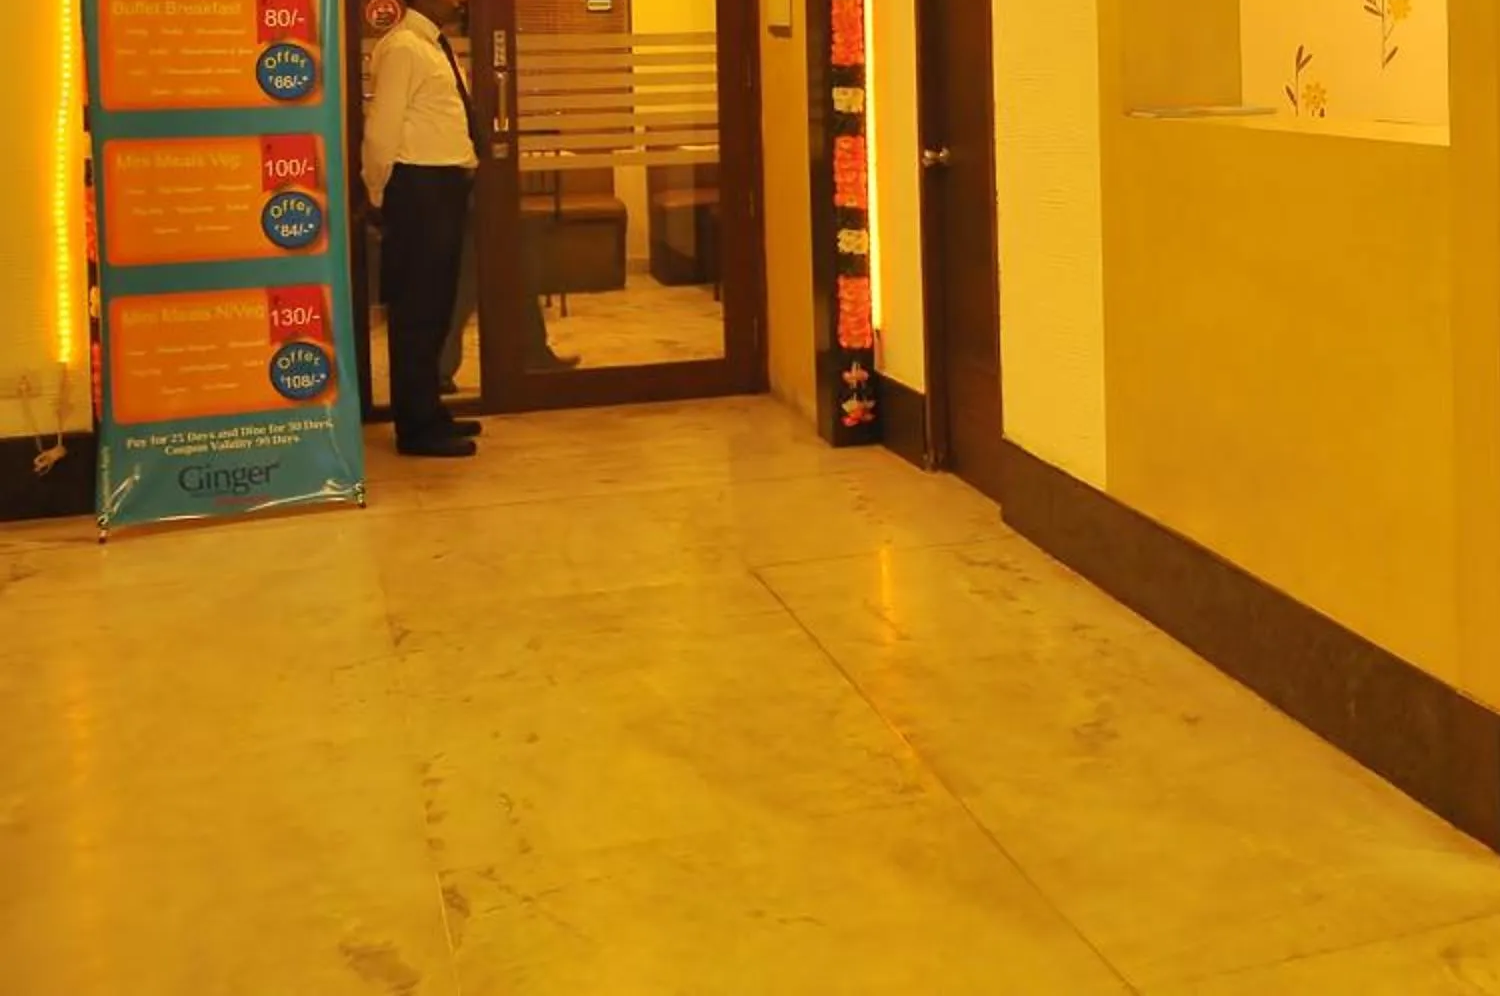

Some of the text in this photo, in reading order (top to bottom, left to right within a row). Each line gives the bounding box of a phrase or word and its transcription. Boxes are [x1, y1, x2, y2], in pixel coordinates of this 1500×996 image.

[264, 9, 305, 27] 80/-
[264, 51, 306, 69] Offer
[264, 159, 315, 177] 100/-
[269, 199, 311, 219] Offer
[271, 307, 320, 326] 130/-
[277, 350, 321, 370] Offer
[178, 462, 280, 496] Ginger
